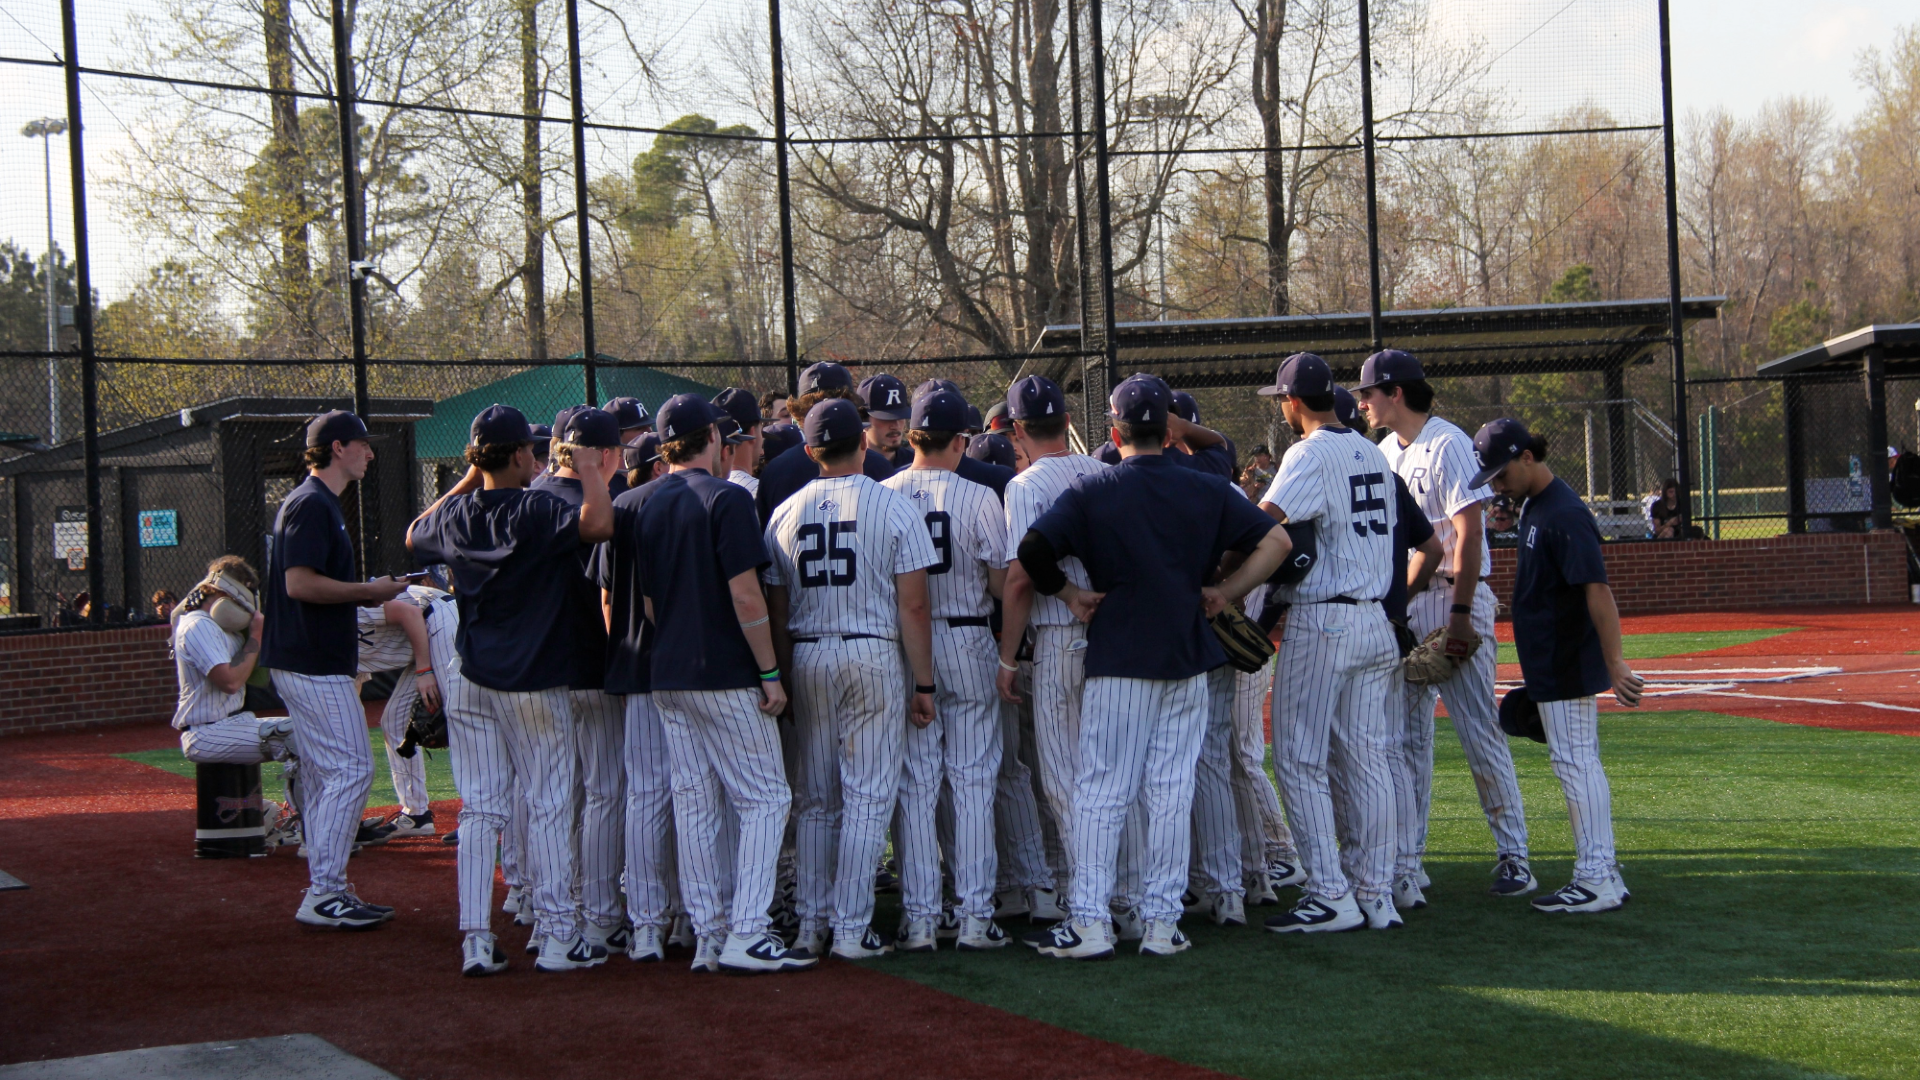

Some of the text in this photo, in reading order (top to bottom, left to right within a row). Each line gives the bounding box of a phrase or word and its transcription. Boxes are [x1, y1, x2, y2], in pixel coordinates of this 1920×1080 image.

[886, 389, 902, 405] R
[635, 403, 648, 418] R
[1408, 467, 1427, 494] R
[1348, 472, 1389, 537] 55
[798, 520, 857, 588] 25
[1558, 889, 1588, 904] N
[323, 901, 354, 916] N
[1293, 903, 1327, 922] N
[574, 941, 592, 958] N
[756, 942, 789, 957] N
